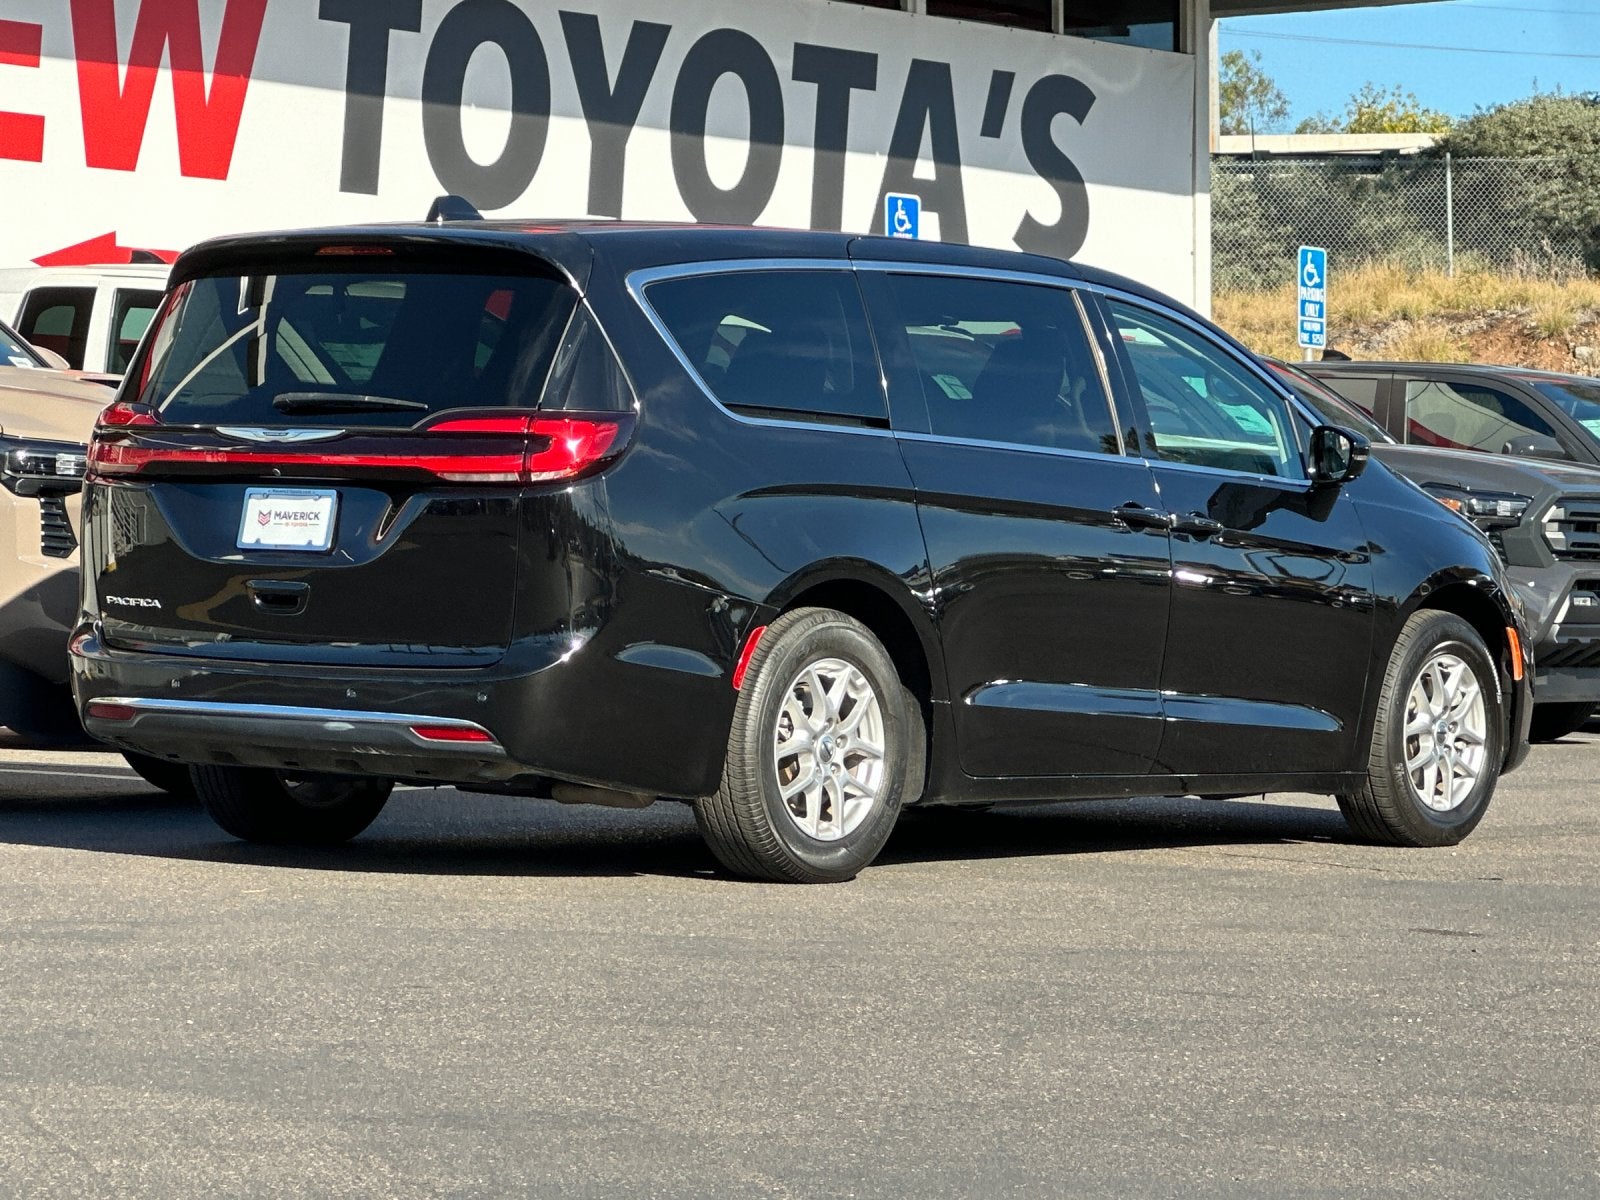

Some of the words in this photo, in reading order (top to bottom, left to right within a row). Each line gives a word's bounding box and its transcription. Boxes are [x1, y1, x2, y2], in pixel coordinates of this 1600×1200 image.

[318, 0, 1097, 260] TOYOTA'S
[1300, 286, 1324, 302] PARKING
[1304, 302, 1320, 317] ONLY
[273, 510, 321, 521] MAVERICK
[105, 595, 162, 609] PACIFICA
